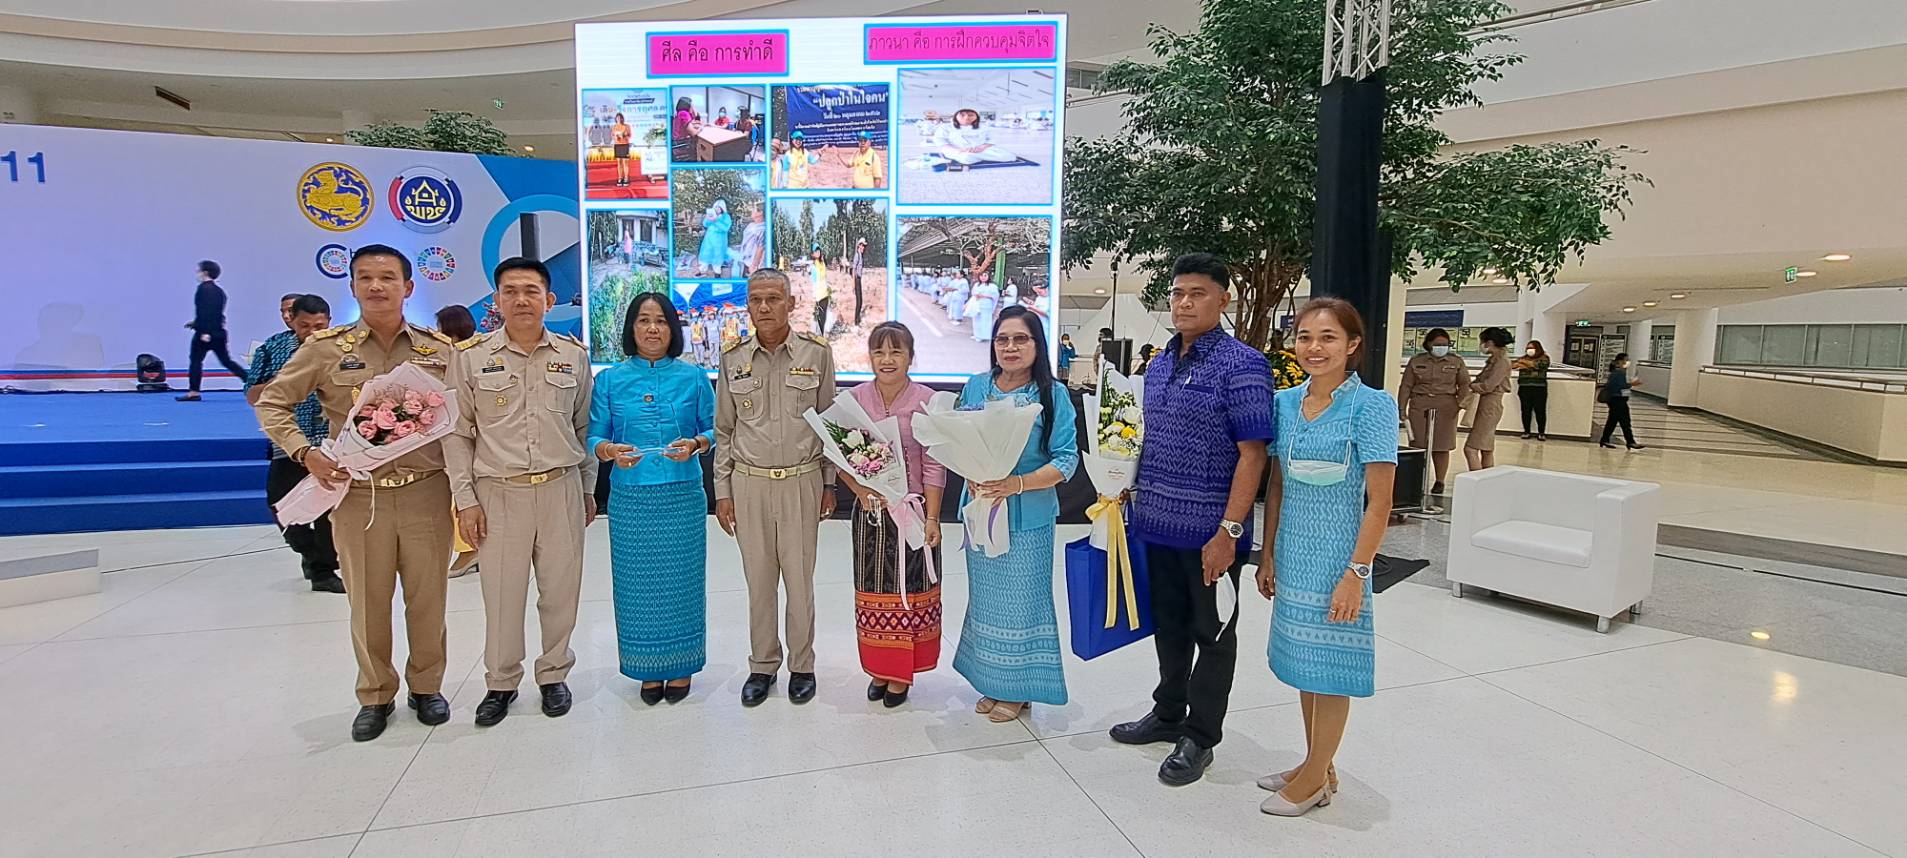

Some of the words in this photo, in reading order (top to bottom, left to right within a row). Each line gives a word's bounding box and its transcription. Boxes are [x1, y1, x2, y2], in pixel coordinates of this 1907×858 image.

[662, 40, 682, 61] ศีล
[688, 39, 708, 61] คือ
[715, 38, 773, 61] การทำดี
[869, 36, 909, 50] ภาวนา
[913, 31, 930, 49] คือ
[934, 29, 1050, 53] การฝึกควบคุมจิตใจ
[0, 150, 45, 183] 11
